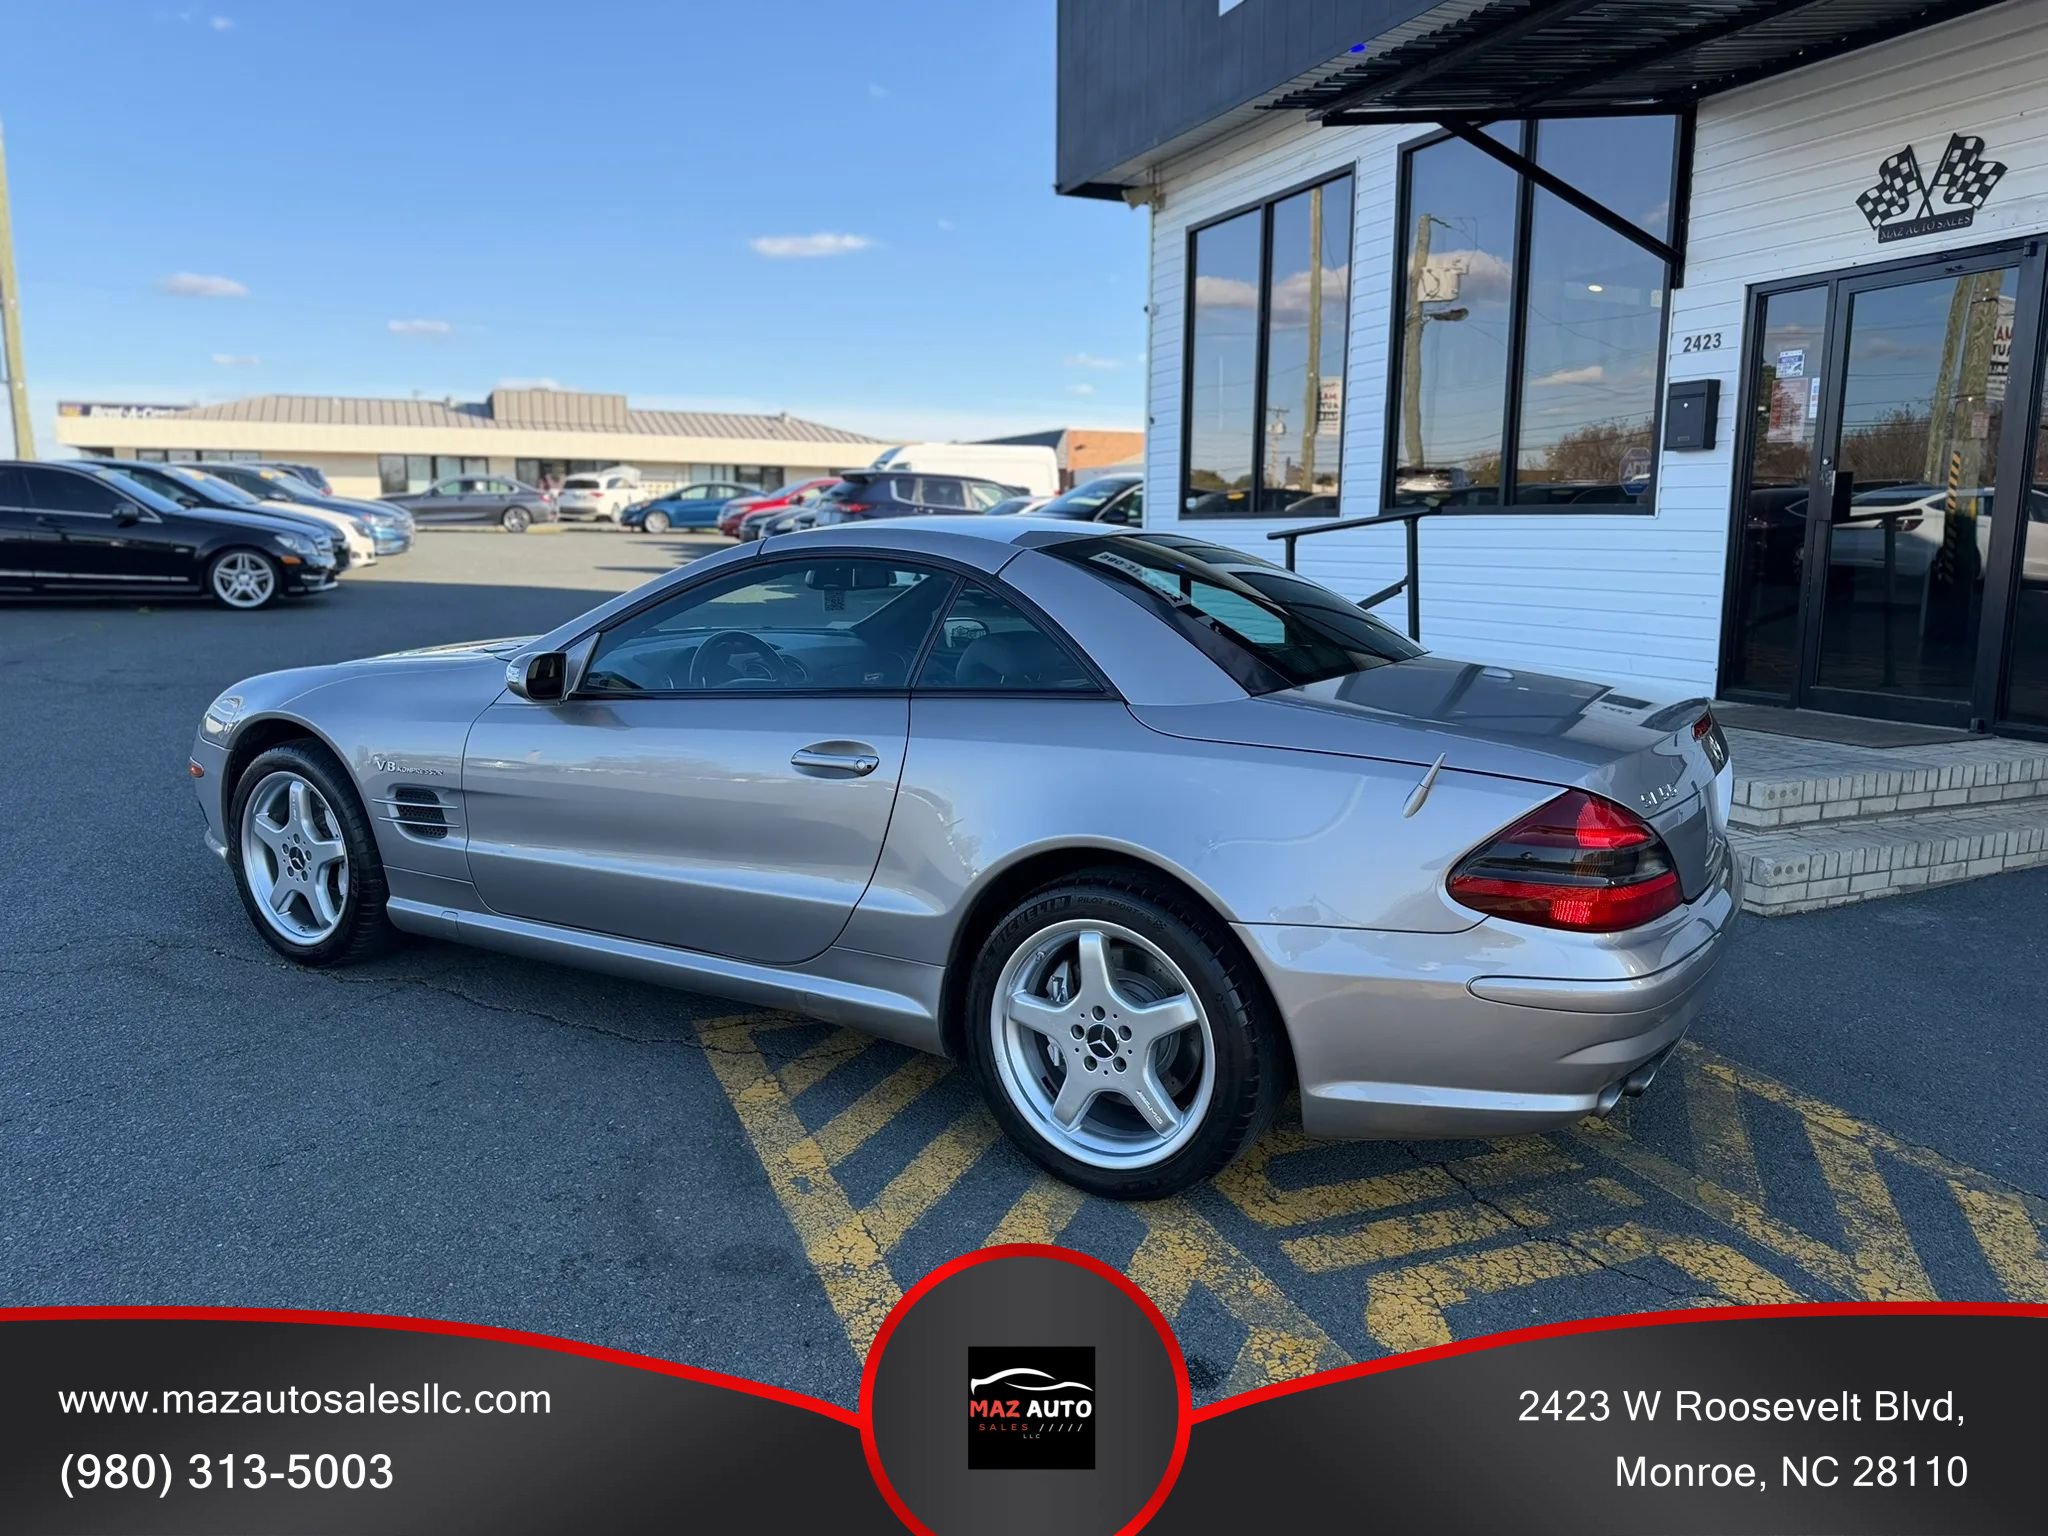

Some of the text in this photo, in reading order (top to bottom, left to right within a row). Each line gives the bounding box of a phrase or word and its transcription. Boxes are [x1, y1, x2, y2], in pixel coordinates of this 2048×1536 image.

[1880, 214, 1970, 240] MAZ AUTO SALES
[1682, 332, 1722, 353] 2423
[991, 895, 1140, 947] MICHELIN PILOT SPORT
